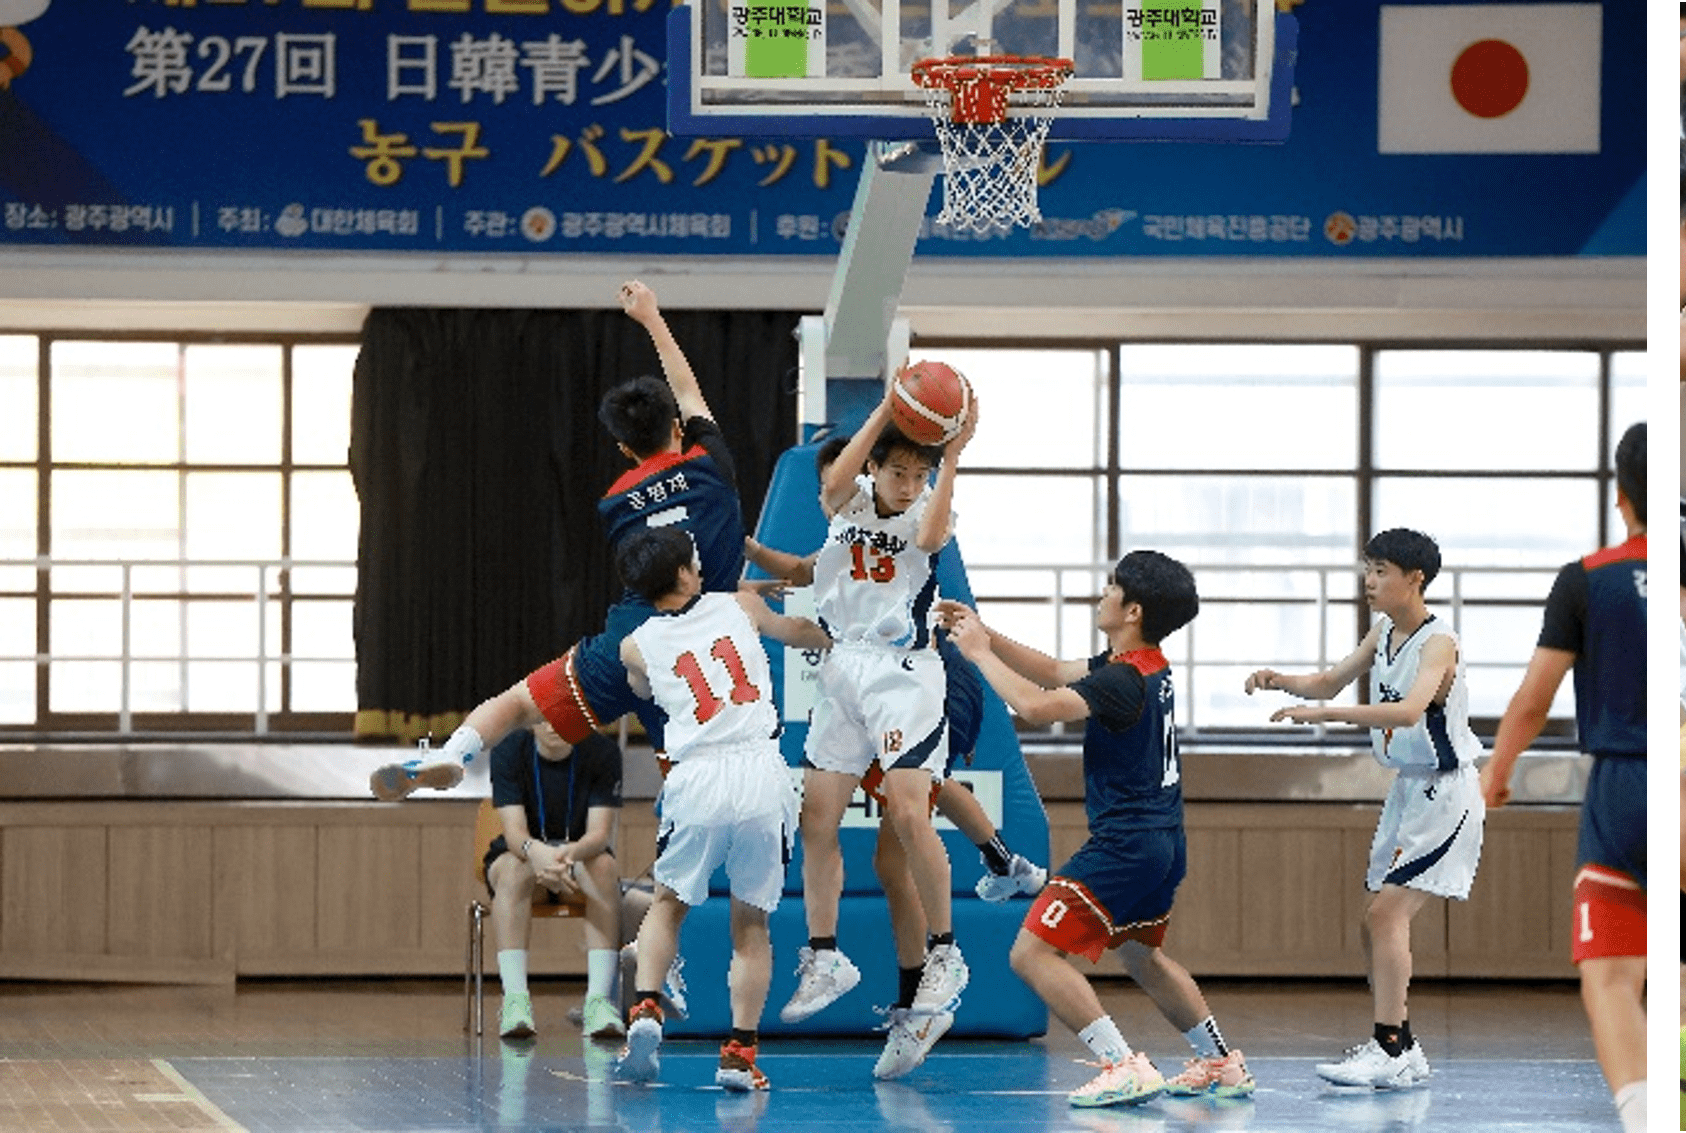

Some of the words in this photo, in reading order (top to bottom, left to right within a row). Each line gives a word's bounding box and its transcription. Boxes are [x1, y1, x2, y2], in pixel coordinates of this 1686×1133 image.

[732, 6, 823, 26] 광주대학교
[1126, 8, 1217, 28] 광주대학교
[122, 26, 337, 99] 第27回
[386, 33, 668, 105] 日韓青少
[348, 119, 491, 188] 농구
[64, 204, 176, 232] 광주광역시
[671, 635, 760, 725] 11
